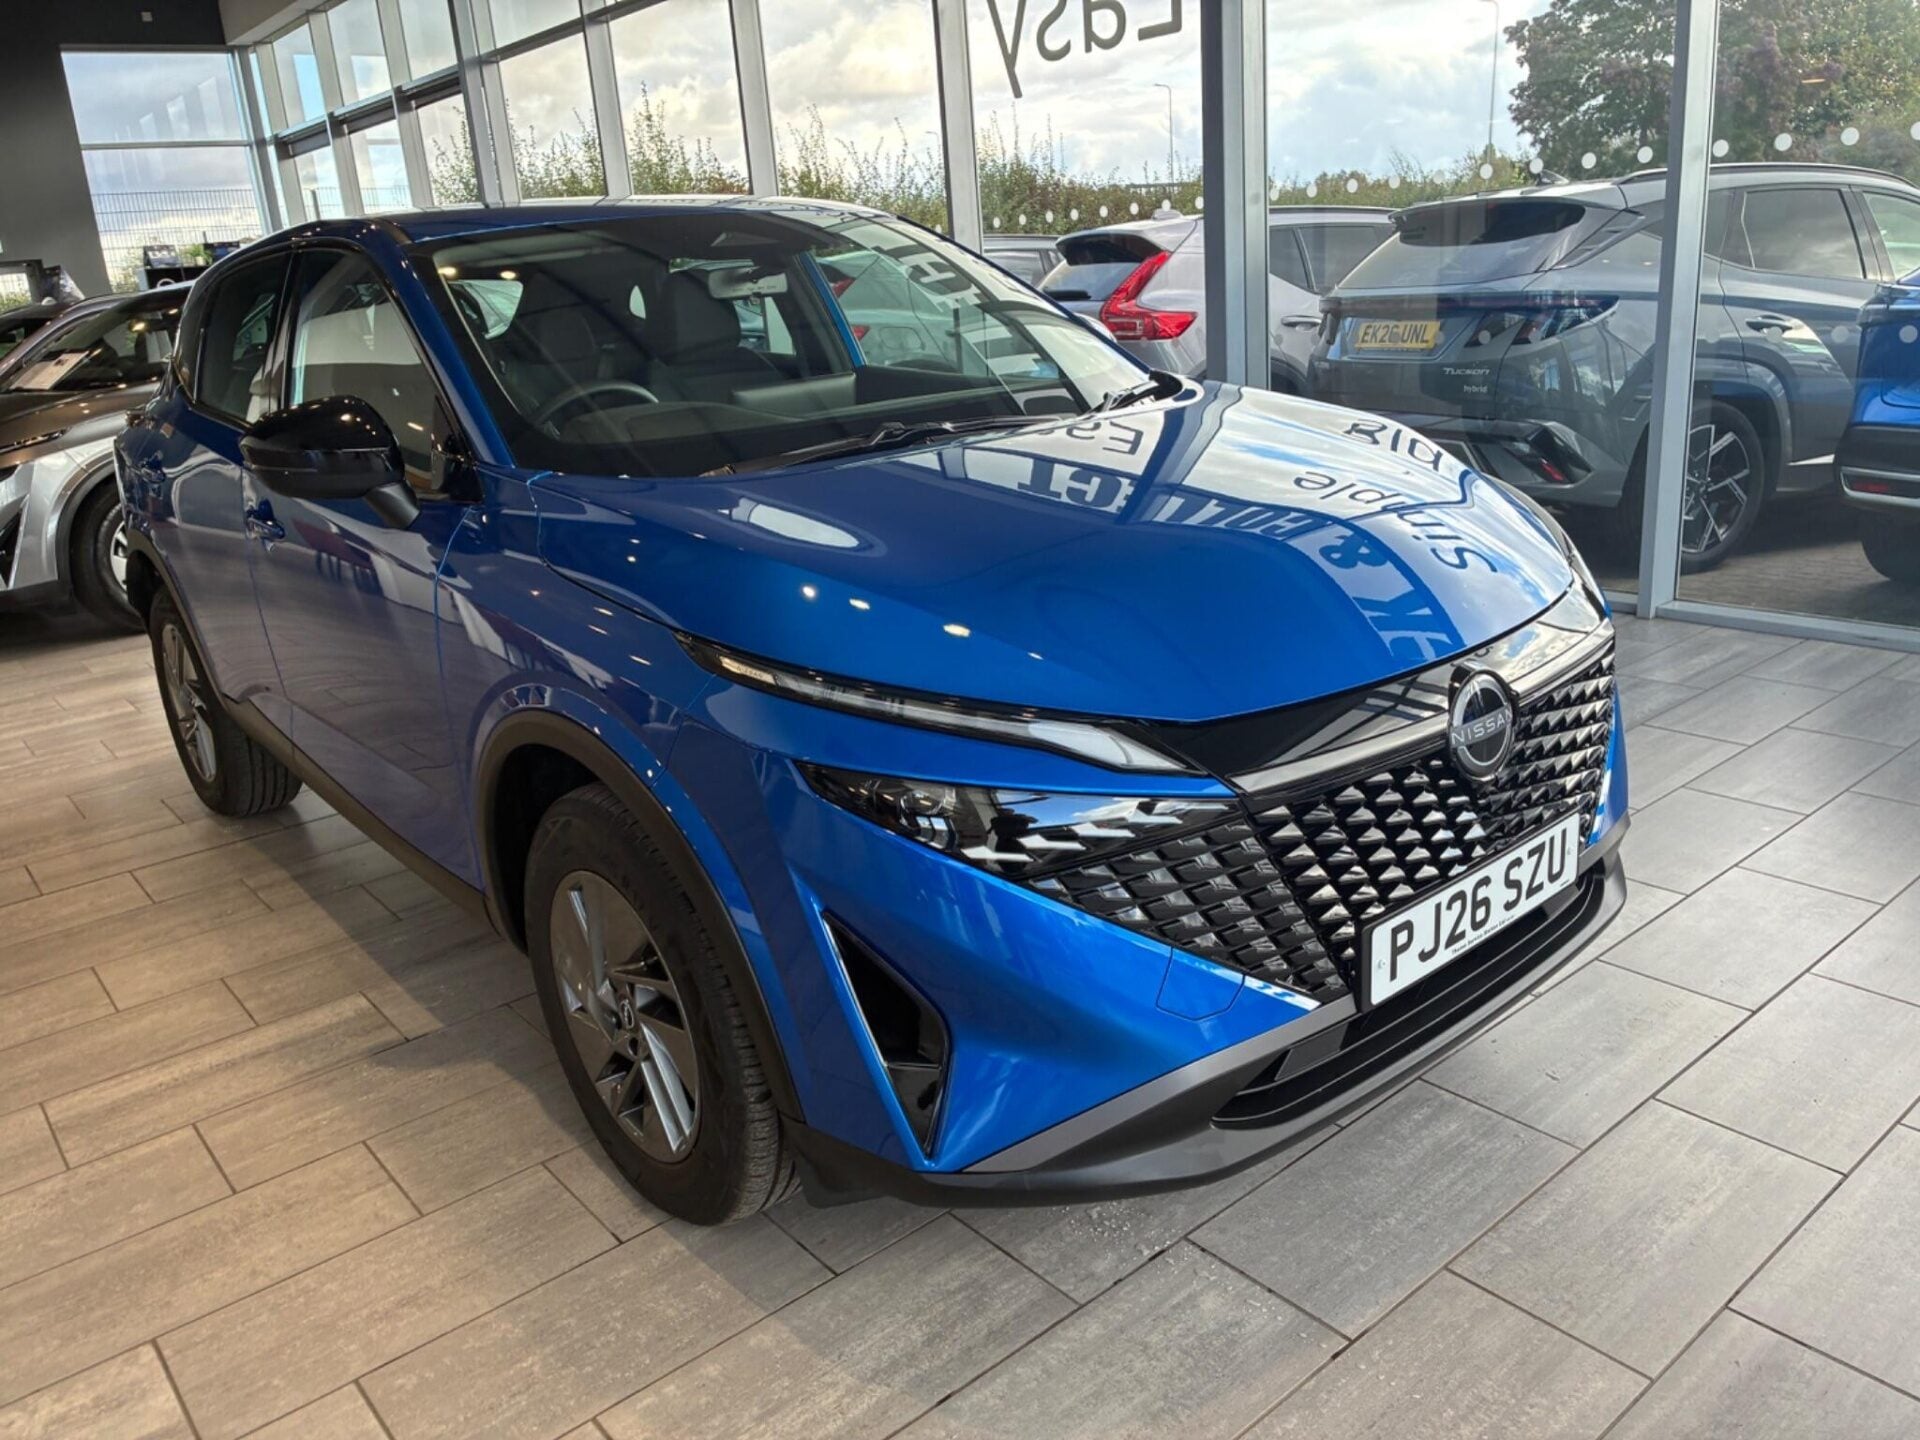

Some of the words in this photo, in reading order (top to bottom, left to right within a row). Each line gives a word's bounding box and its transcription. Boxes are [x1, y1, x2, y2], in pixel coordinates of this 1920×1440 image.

[1400, 323, 1431, 343] UNL
[1451, 709, 1513, 745] NISSAN
[1389, 875, 1492, 983] PJ26
[1503, 827, 1568, 912] SZU
